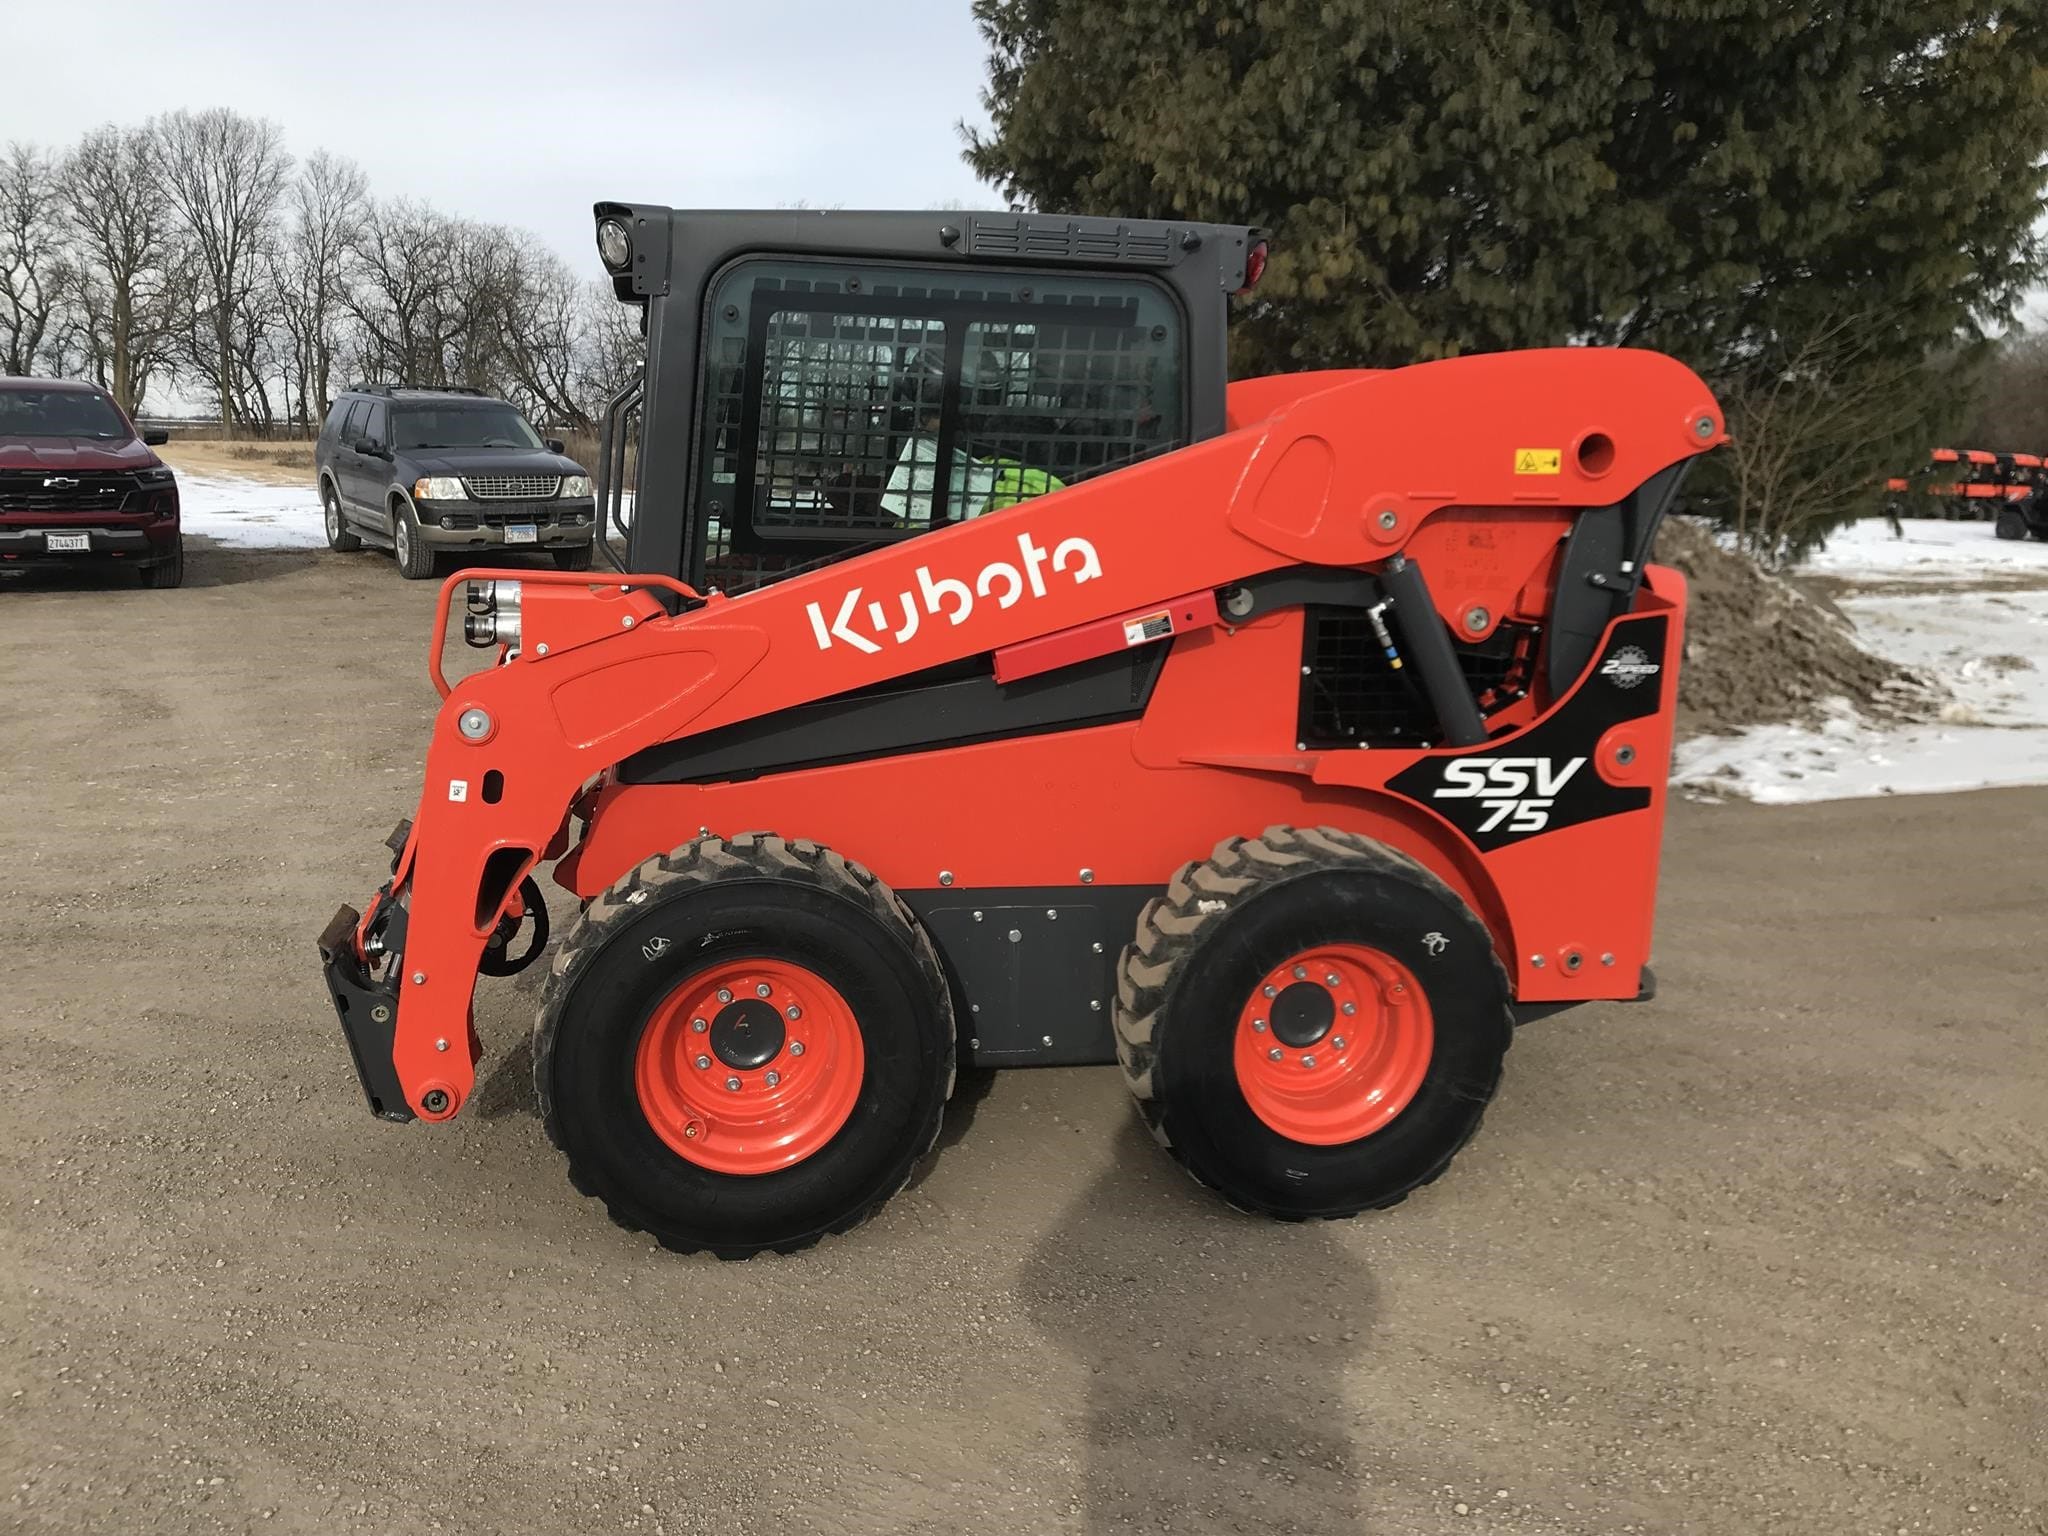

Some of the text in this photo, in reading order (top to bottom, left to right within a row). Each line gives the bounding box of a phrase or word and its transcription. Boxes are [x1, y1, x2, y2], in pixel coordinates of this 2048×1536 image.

[806, 532, 1103, 654] Kubota
[1433, 757, 1588, 798] SSV
[1476, 799, 1555, 833] 75
